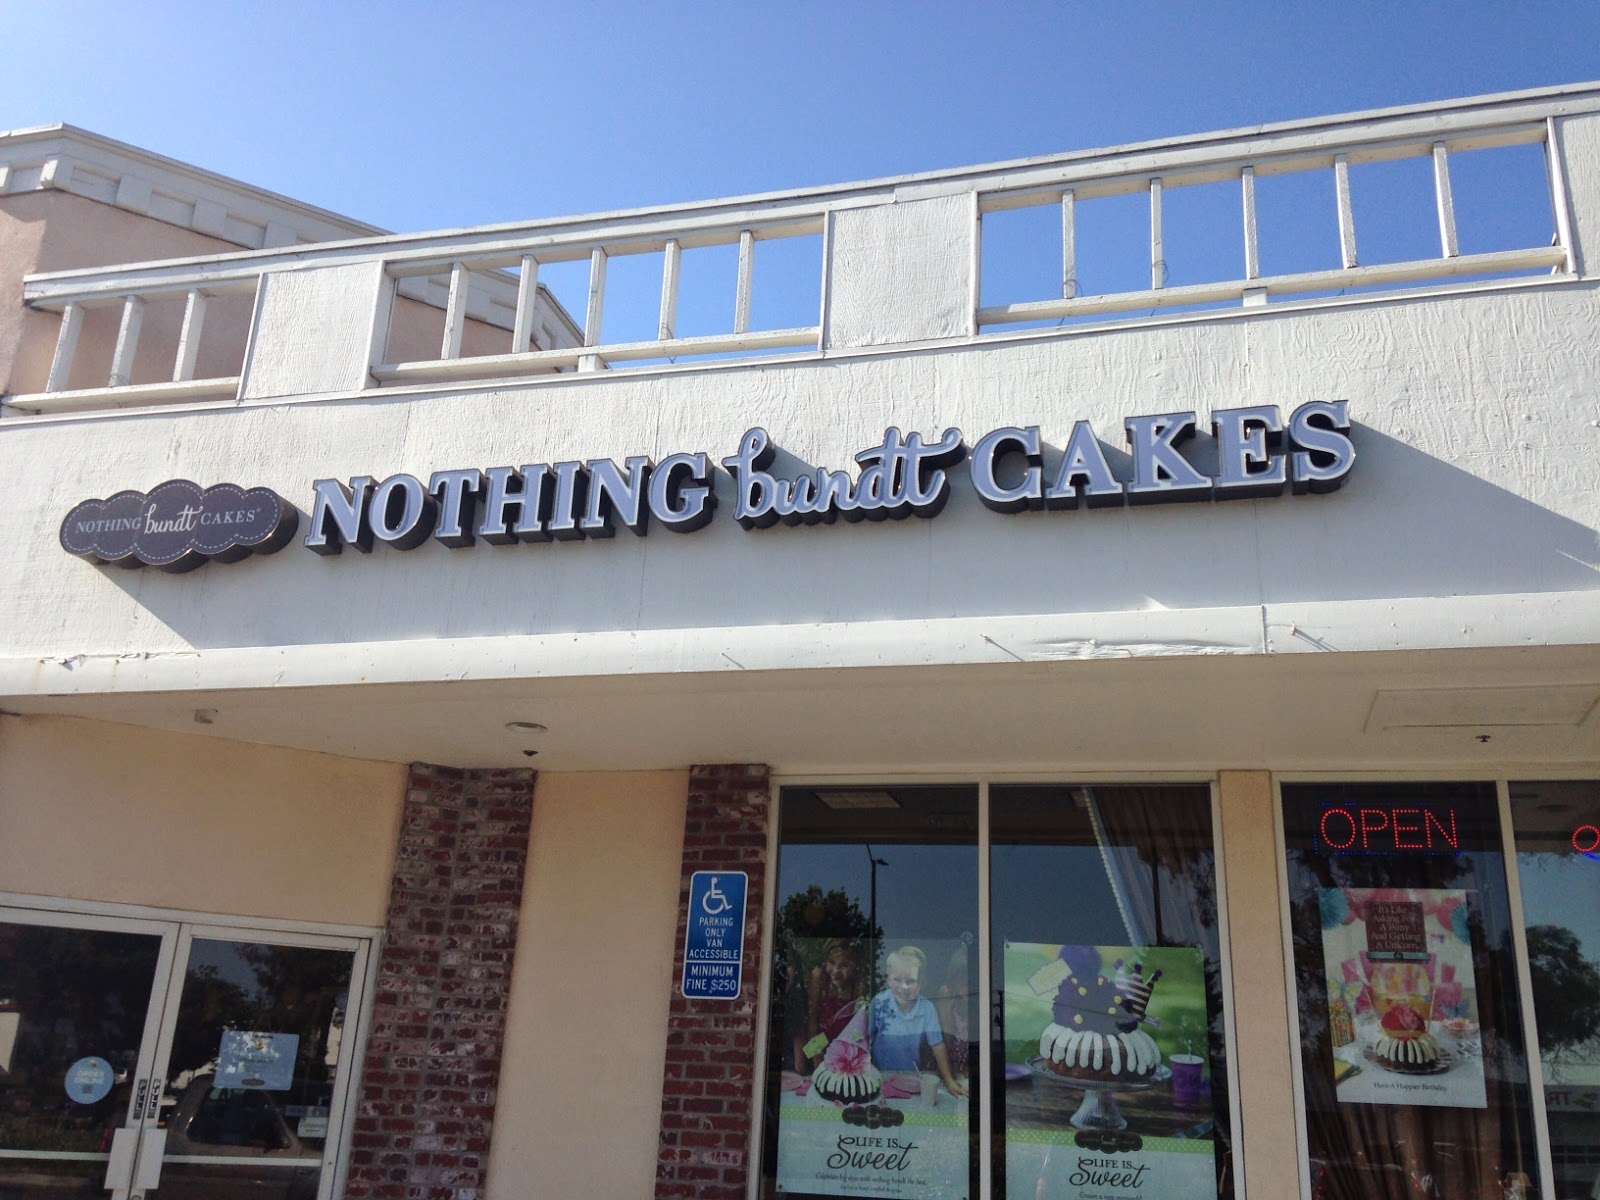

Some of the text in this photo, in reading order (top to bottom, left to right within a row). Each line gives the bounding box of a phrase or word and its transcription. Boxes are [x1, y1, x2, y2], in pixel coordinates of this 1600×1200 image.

[303, 400, 1356, 551] NOTHING bundt CAKES
[75, 503, 256, 535] NOTHING bundt CAKES
[1320, 808, 1459, 849] OPEN
[699, 917, 734, 927] PARKING
[705, 928, 726, 937] ONLY
[706, 939, 723, 947] VAN
[689, 949, 738, 959] ACCESSIBLE
[691, 964, 734, 977] MINIMUM
[686, 979, 737, 991] FINE $250
[136, 1081, 146, 1110] PULL
[149, 1081, 160, 1110] PULL
[856, 1136, 899, 1148] LIFE IS
[827, 1134, 919, 1171] Sweet
[1094, 1158, 1132, 1169] LIFE IS
[1069, 1156, 1151, 1188] Sweet
